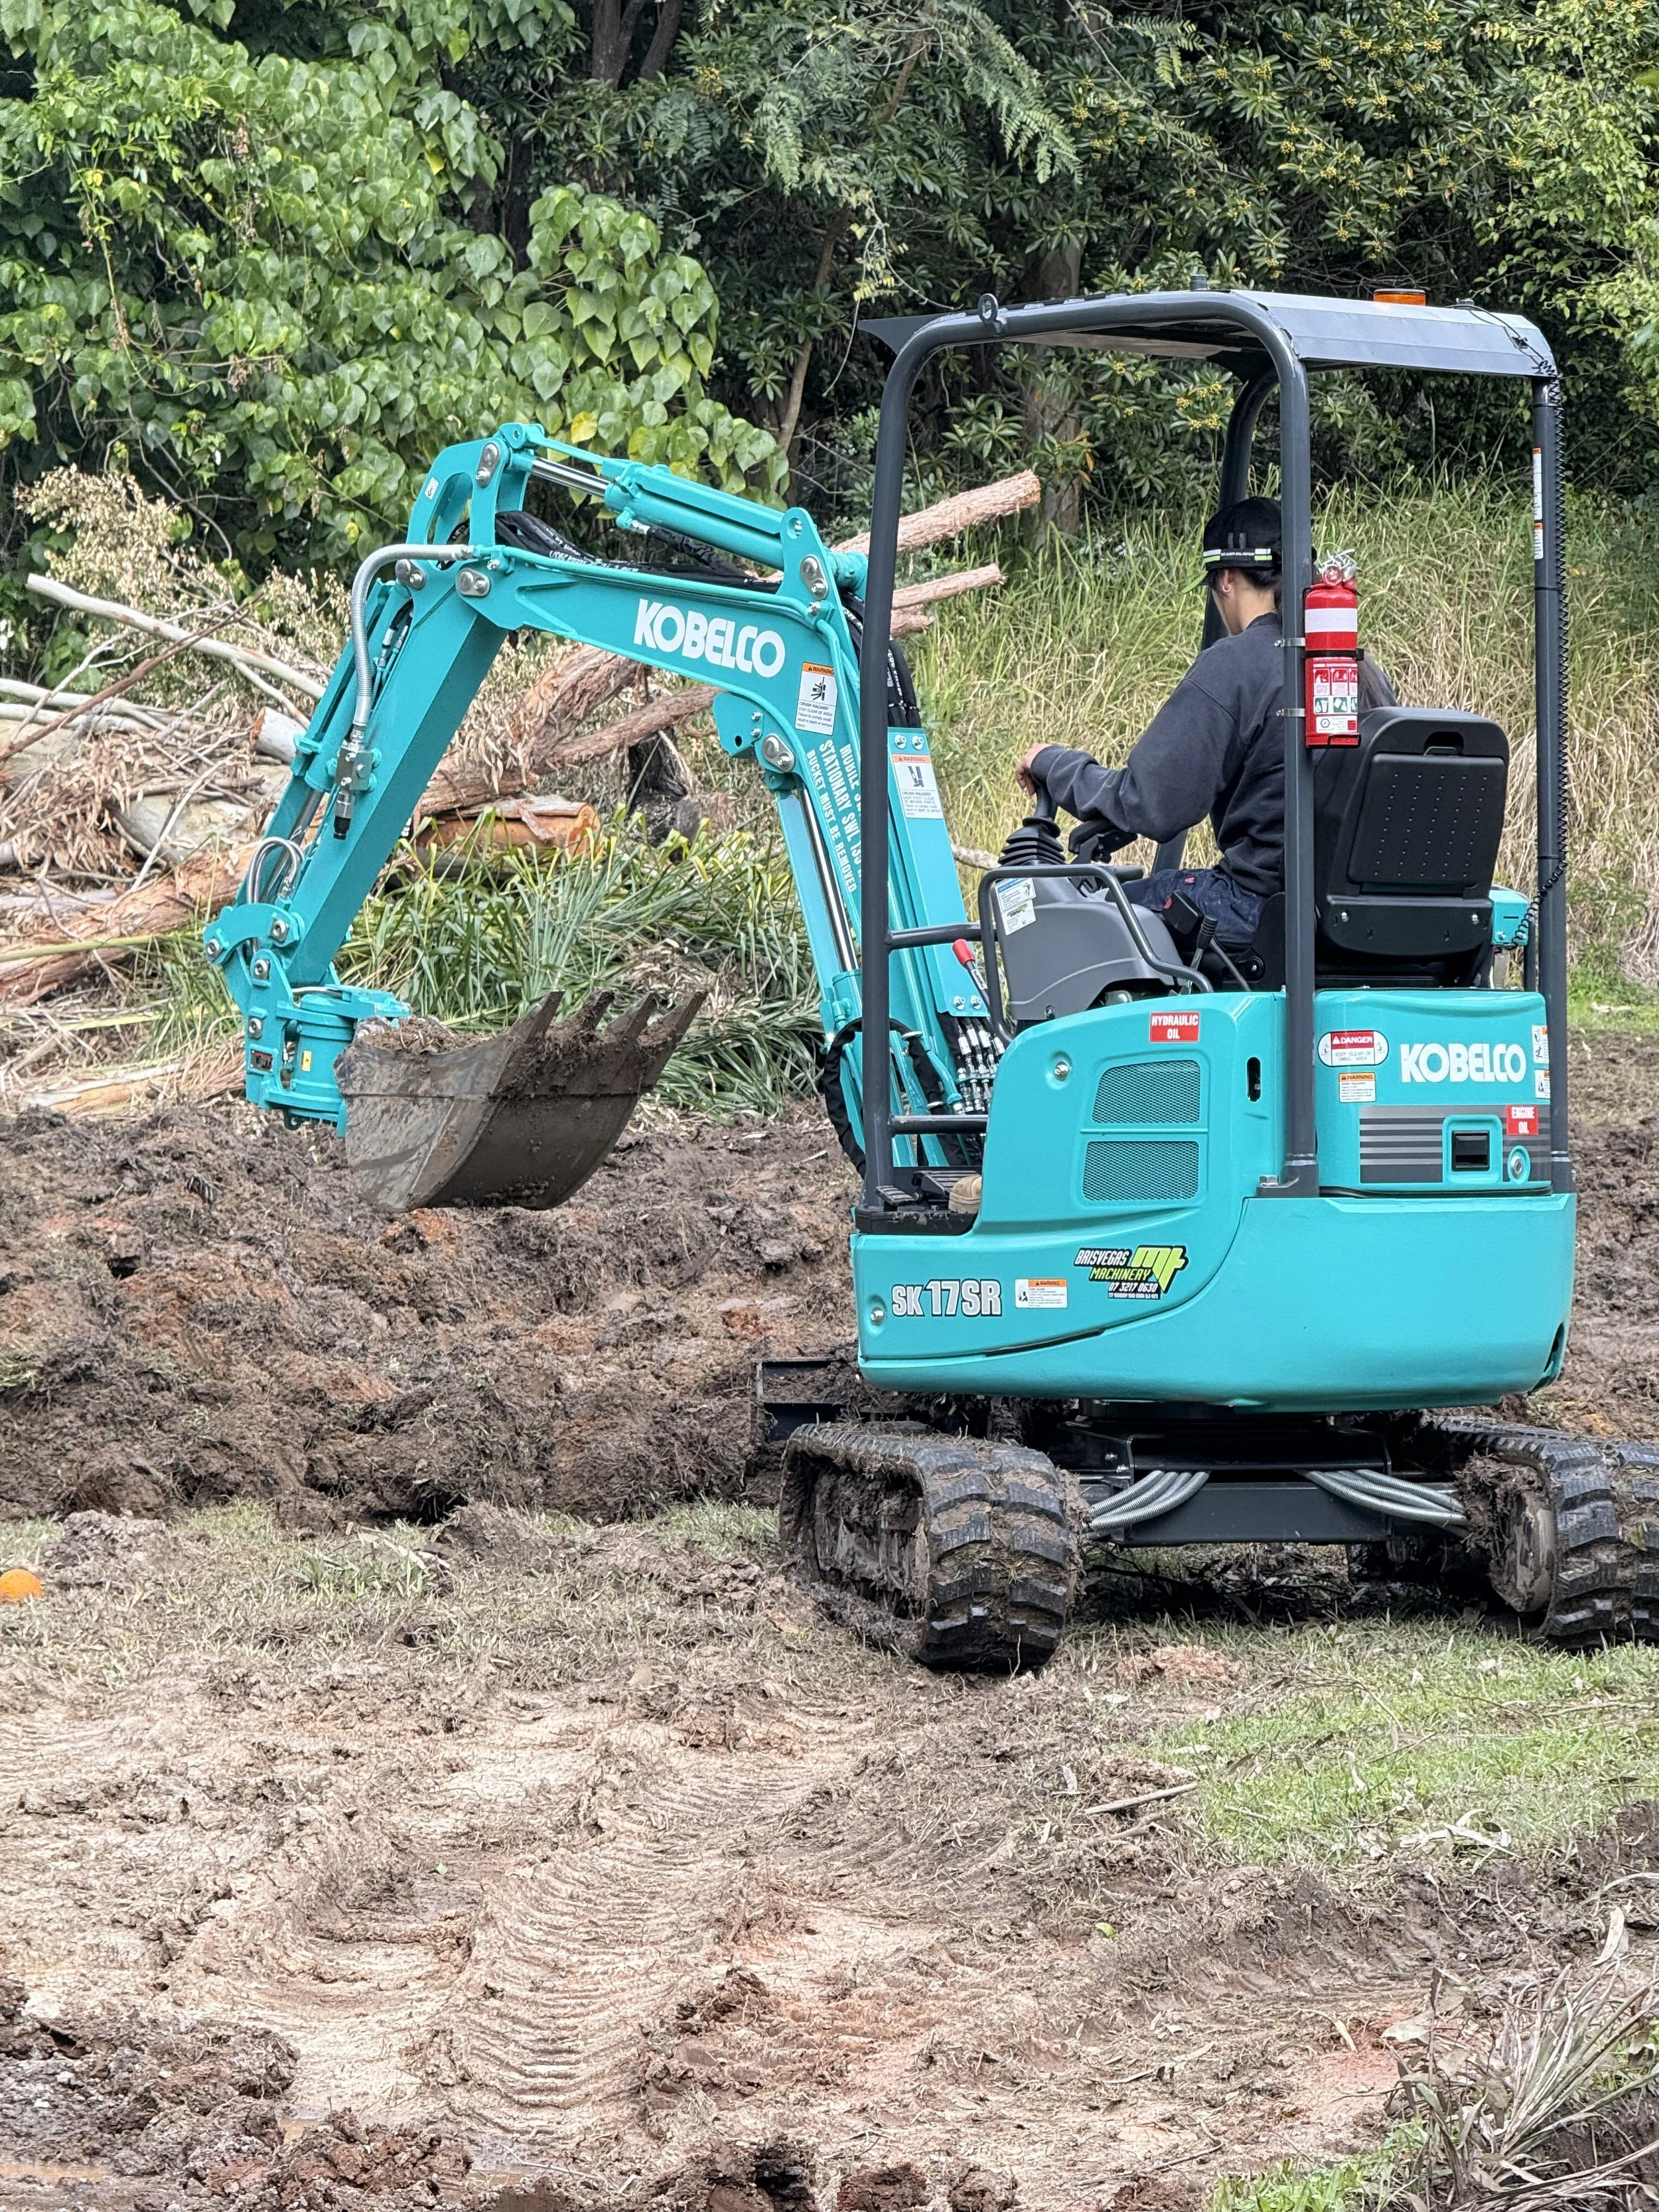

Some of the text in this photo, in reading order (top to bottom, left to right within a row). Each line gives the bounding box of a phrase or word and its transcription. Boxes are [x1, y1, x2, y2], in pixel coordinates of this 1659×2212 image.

[634, 599, 786, 678] KOBELCO
[812, 666, 834, 675] WARNING
[839, 743, 860, 790] MOBILE
[819, 739, 852, 812] STATIONARY
[841, 812, 861, 843] SWL
[806, 749, 857, 893] BUCKET MUST BE REMOVED
[1151, 1015, 1198, 1027] HYDRAULIC
[1167, 1028, 1181, 1039] OIL
[1340, 1036, 1373, 1045] DANGER
[1400, 1043, 1526, 1083] KOBELCO
[1511, 1106, 1535, 1119] ENGINE
[1518, 1122, 1530, 1134] OIL
[1074, 1249, 1129, 1266] BRISVEGAS
[1090, 1268, 1151, 1282] MACHINERY
[1108, 1282, 1159, 1293] 07 3217 0630
[892, 1280, 1002, 1317] SK17SR
